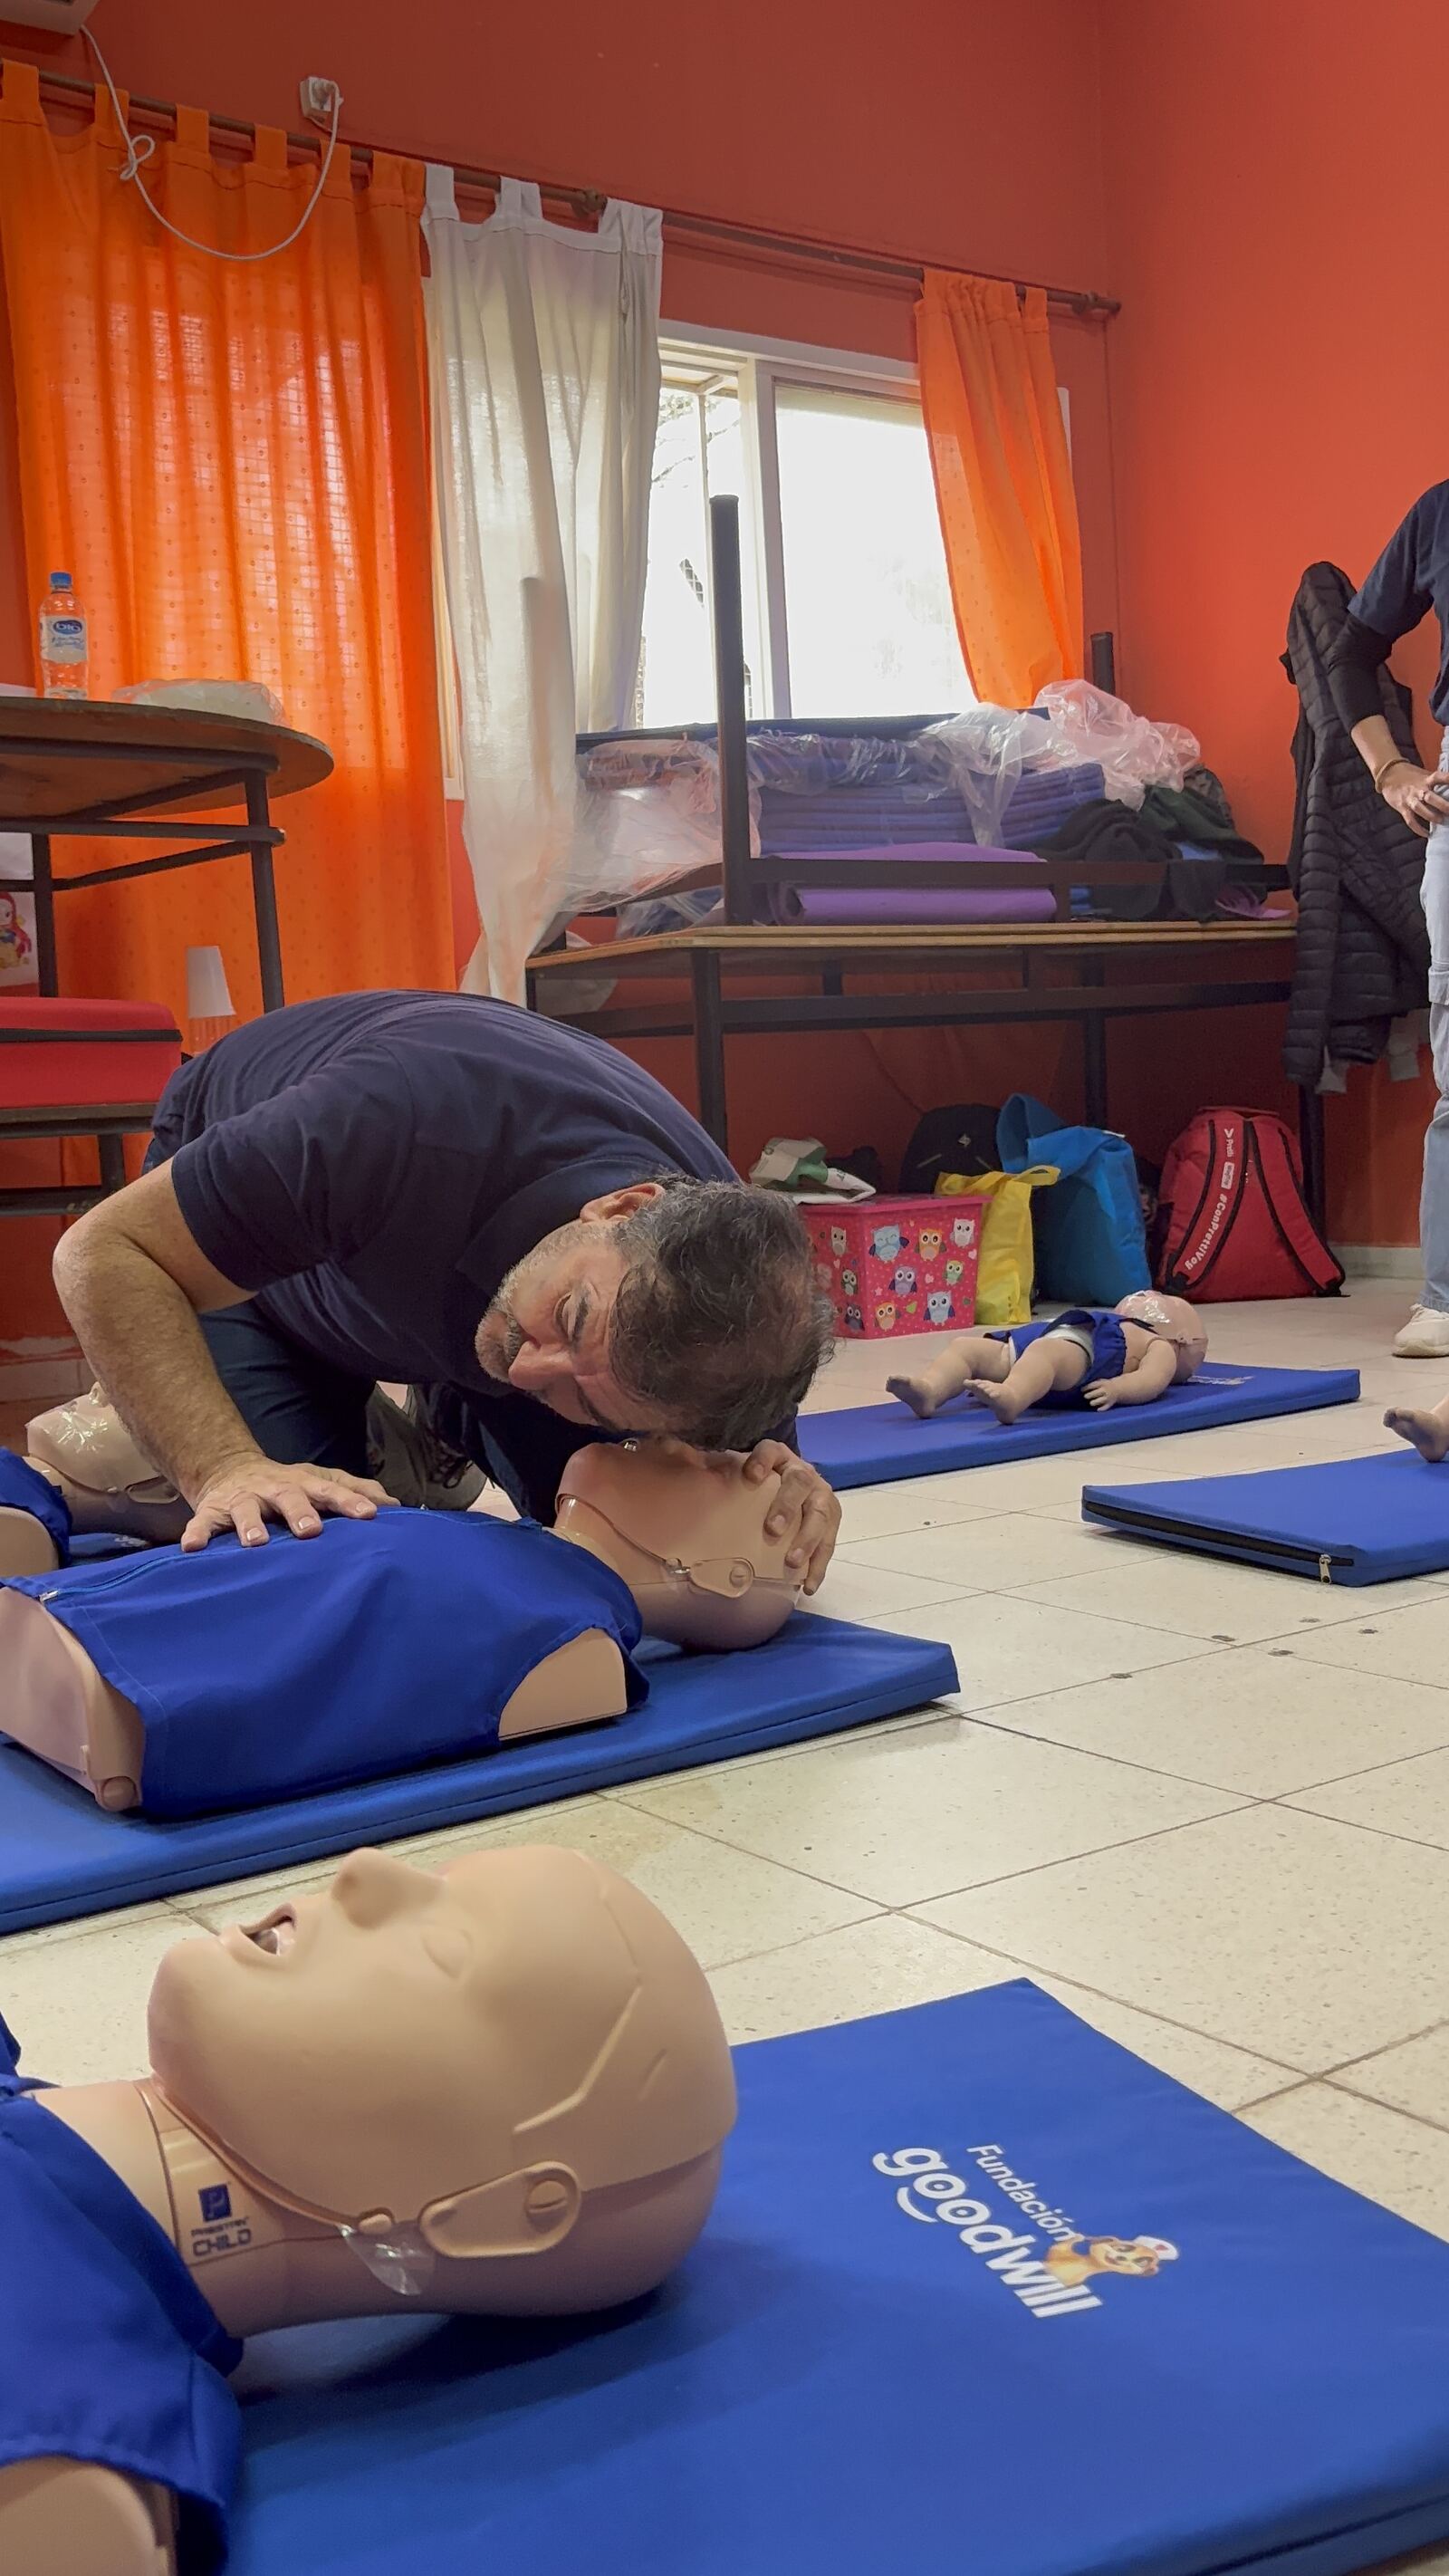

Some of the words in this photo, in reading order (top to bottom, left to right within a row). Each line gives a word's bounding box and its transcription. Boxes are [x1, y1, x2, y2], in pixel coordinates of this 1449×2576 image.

[193, 2228, 252, 2256] CHILD
[872, 2147, 1103, 2318] goodwill
[966, 2144, 1081, 2242] Fundación
